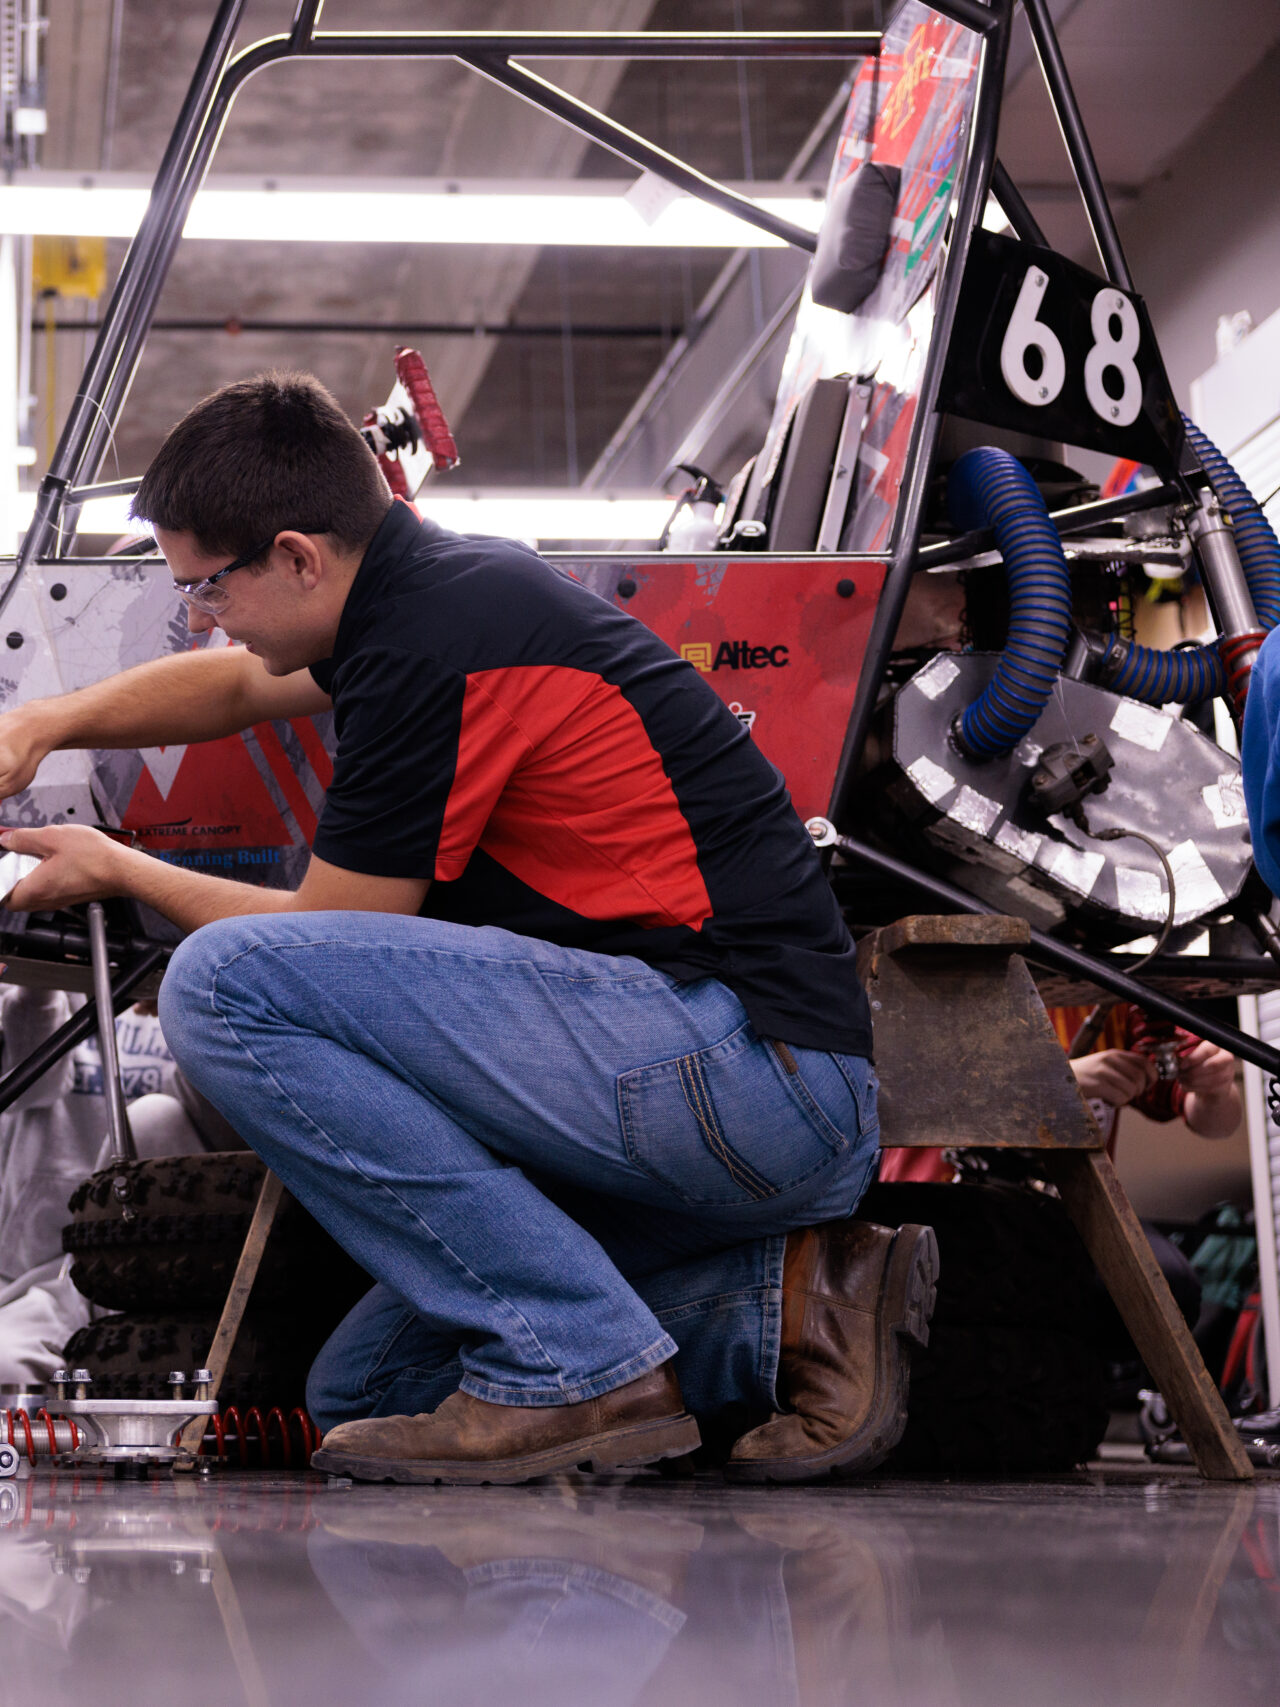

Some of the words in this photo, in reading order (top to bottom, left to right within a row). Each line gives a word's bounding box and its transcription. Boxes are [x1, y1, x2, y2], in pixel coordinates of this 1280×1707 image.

[1000, 264, 1143, 427] 68
[711, 640, 789, 671] Altec
[138, 825, 188, 837] EXTREME
[191, 825, 242, 836] CANOPY
[237, 849, 281, 865] Built
